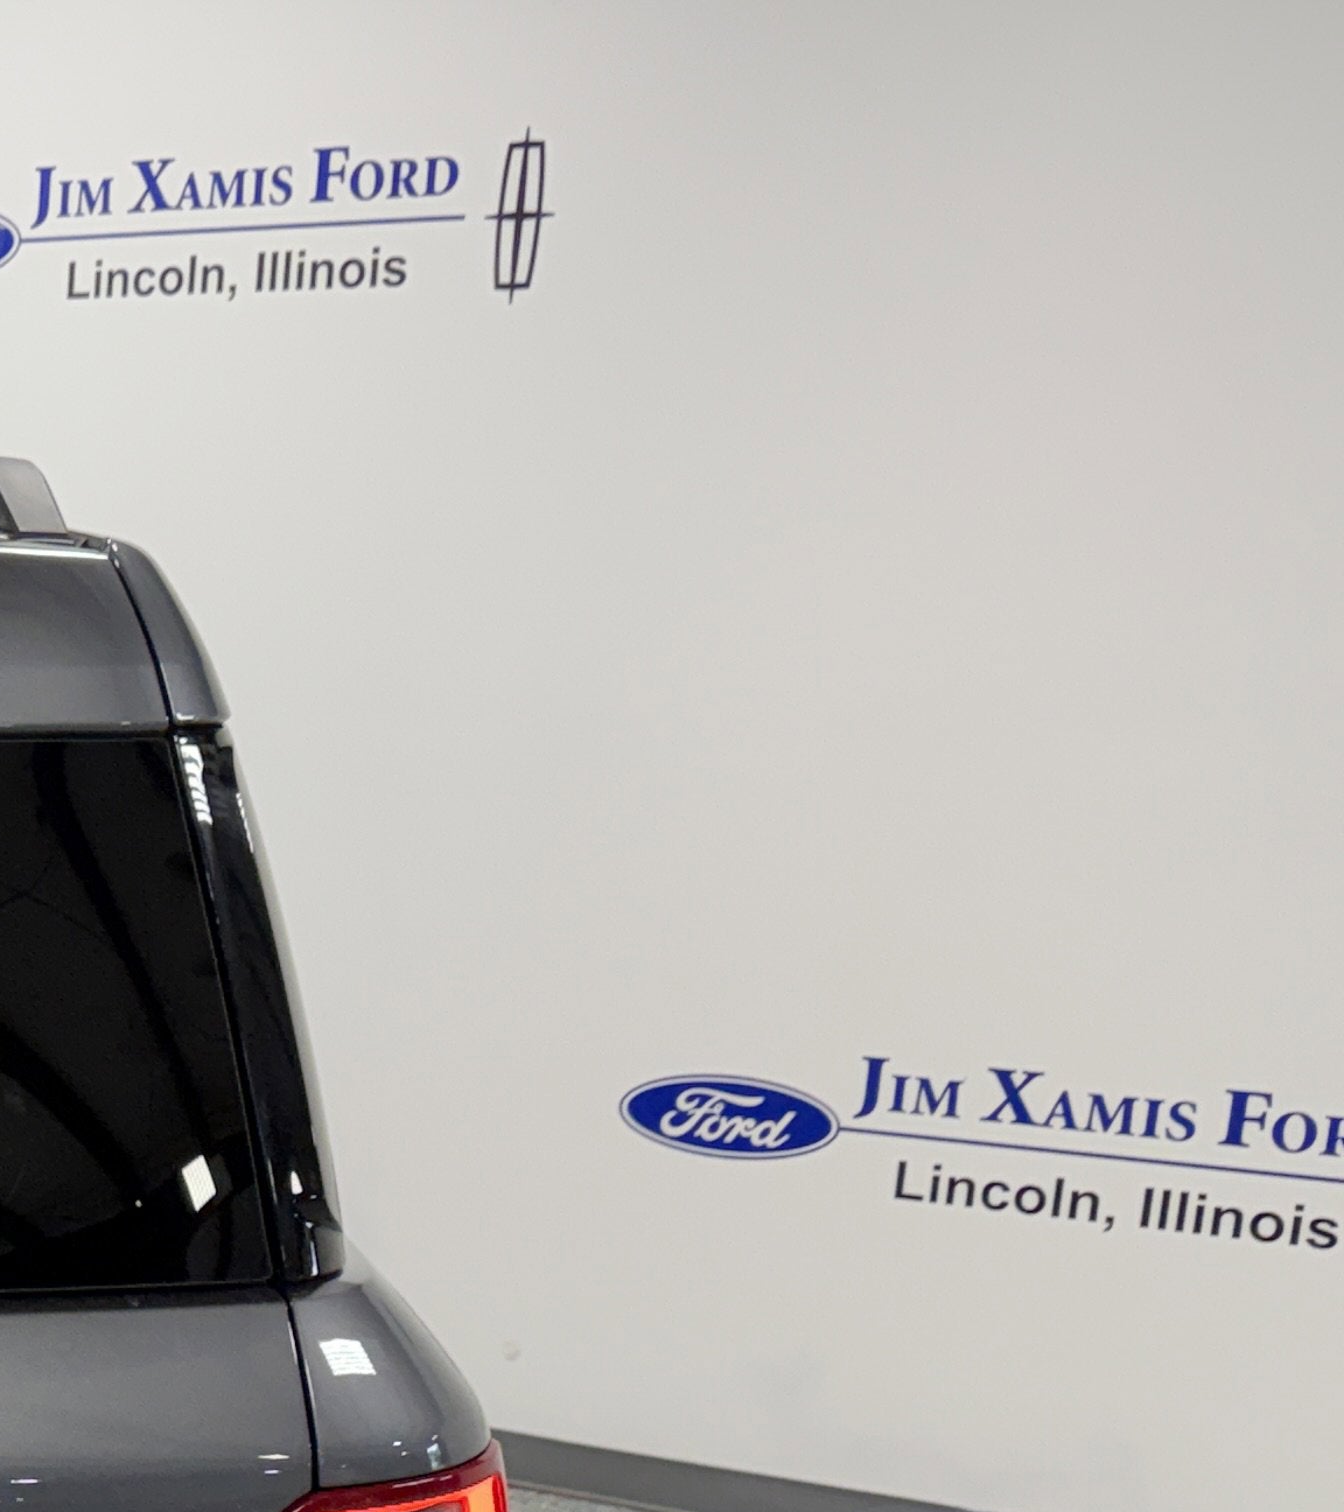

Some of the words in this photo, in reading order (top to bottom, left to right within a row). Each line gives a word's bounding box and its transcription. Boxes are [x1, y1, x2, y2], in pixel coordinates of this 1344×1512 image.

[30, 166, 114, 227] JIM
[126, 158, 293, 214] XAMIS
[310, 146, 460, 202] FORD
[67, 254, 238, 300] Lincoln,
[254, 247, 408, 293] Illinois
[659, 1086, 795, 1151] Ford
[853, 1056, 966, 1120] JIM
[980, 1067, 1198, 1142] XAMIS
[893, 1160, 1116, 1233] Lincoln,
[1139, 1187, 1340, 1251] Illinois
